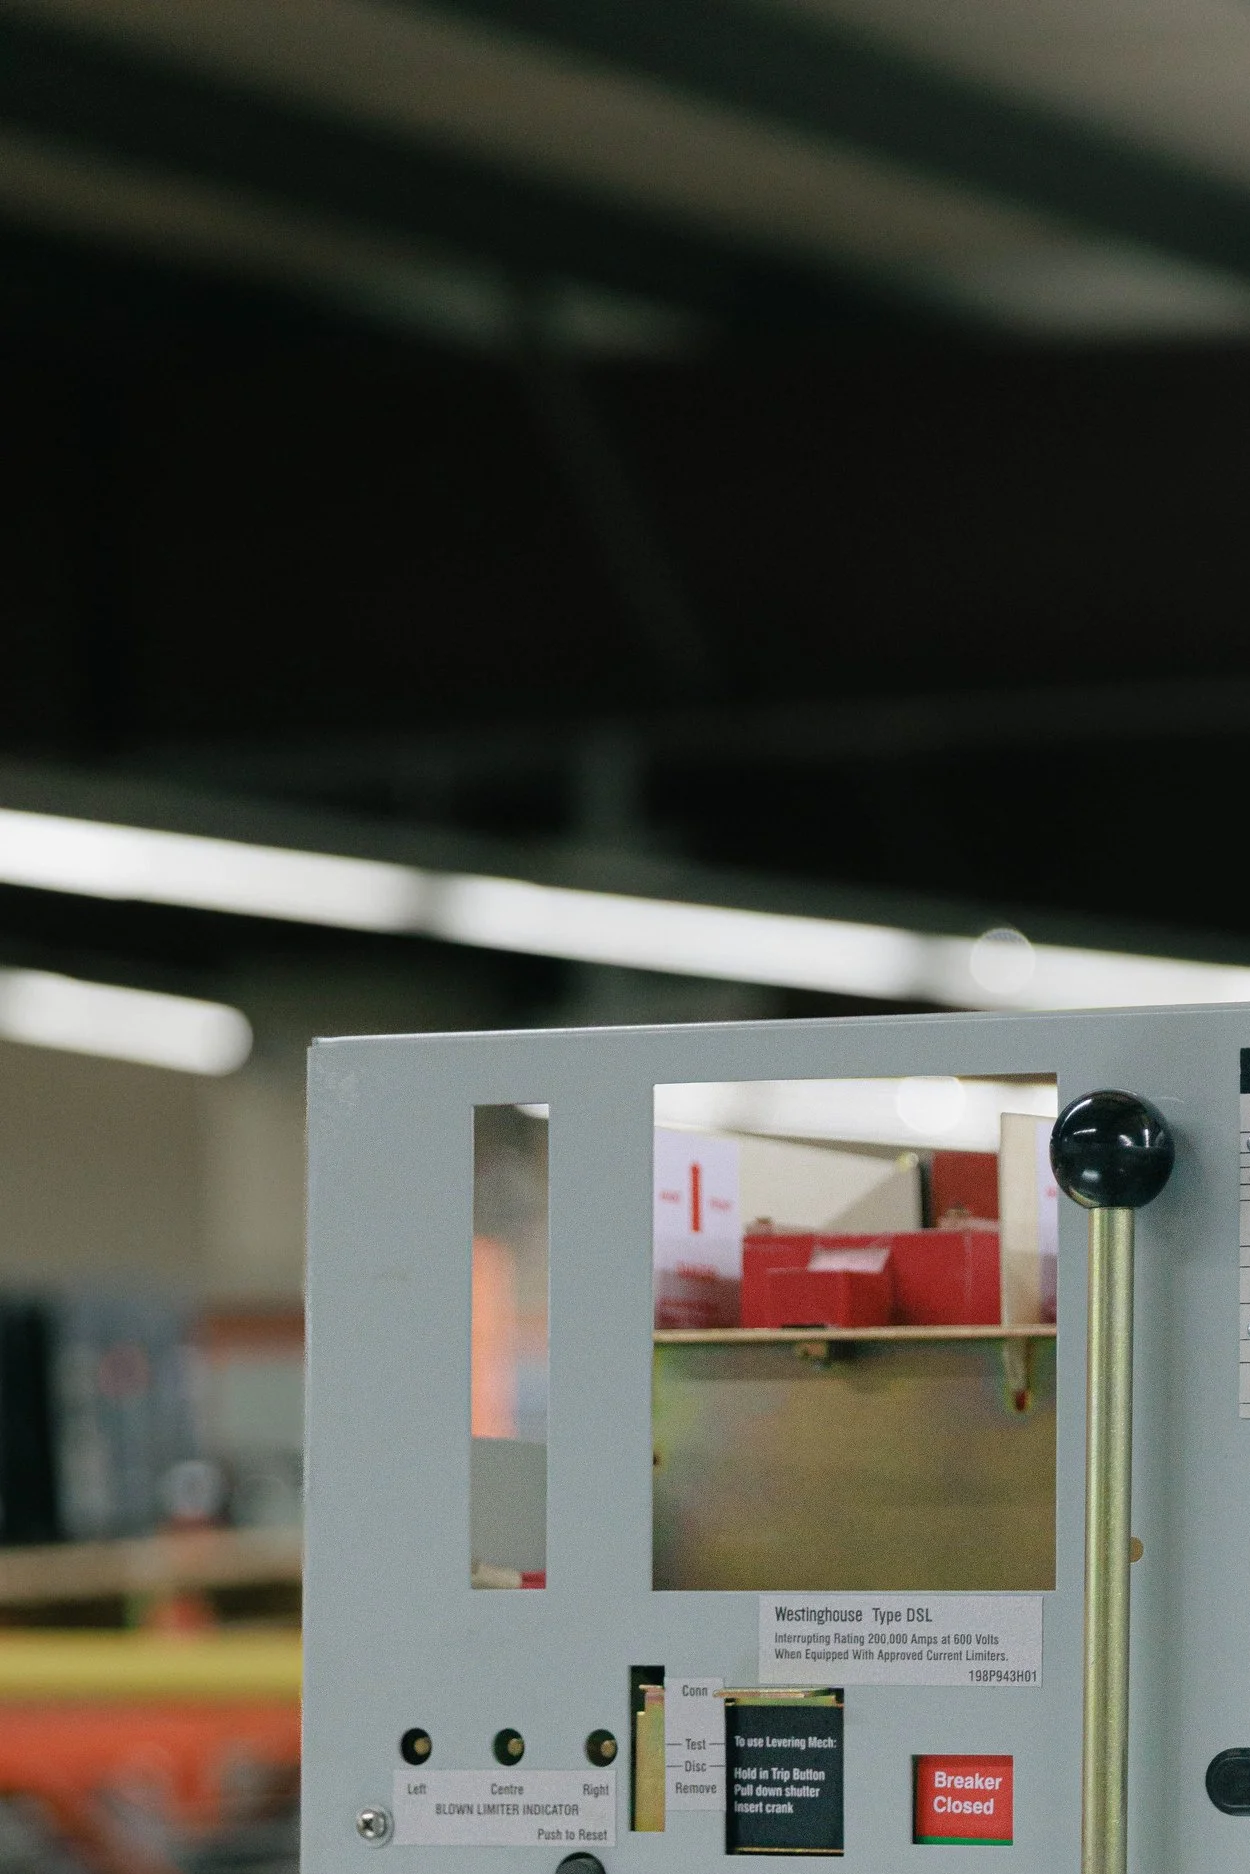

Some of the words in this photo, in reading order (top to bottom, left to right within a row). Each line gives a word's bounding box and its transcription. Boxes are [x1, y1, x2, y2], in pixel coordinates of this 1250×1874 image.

[775, 1606, 862, 1624] Westinghouse
[872, 1608, 901, 1625] Type
[907, 1608, 932, 1622] DSL
[774, 1633, 830, 1646] Interrupting
[834, 1633, 864, 1646] Rating
[911, 1634, 937, 1646] Amps
[941, 1635, 950, 1644] at
[954, 1634, 972, 1644] 600
[976, 1634, 999, 1644] Volts
[774, 1649, 801, 1660] When
[805, 1649, 848, 1661] Equipped
[852, 1650, 874, 1660] With
[878, 1650, 923, 1662] Approved
[927, 1650, 962, 1660] Current
[966, 1650, 1008, 1661] Limiters.
[969, 1670, 1037, 1682] 198P943H01
[682, 1685, 708, 1697] Conn
[686, 1739, 706, 1750] Test
[735, 1736, 745, 1747] To
[748, 1739, 763, 1747] use
[766, 1736, 806, 1749] Levering
[808, 1737, 837, 1748] Mech:
[685, 1760, 706, 1771] Disc
[734, 1768, 756, 1779] Hold
[760, 1769, 769, 1779] in
[772, 1769, 788, 1781] Trip
[793, 1769, 825, 1780] Button
[934, 1771, 1001, 1790] Breaker
[408, 1784, 426, 1795] Left
[491, 1784, 524, 1795] Centre
[583, 1784, 608, 1797] Right
[676, 1782, 717, 1794] Remove
[734, 1786, 752, 1796] Pull
[756, 1785, 782, 1797] down
[785, 1786, 819, 1797] shutter
[436, 1804, 473, 1815] BLOWN
[477, 1804, 519, 1815] LIMITER
[523, 1805, 579, 1815] INDICATOR
[735, 1802, 763, 1813] Insert
[766, 1802, 793, 1813] crank
[933, 1796, 993, 1815] Closed
[538, 1830, 562, 1840] Push
[566, 1830, 575, 1840] to
[579, 1830, 607, 1841] Reset
